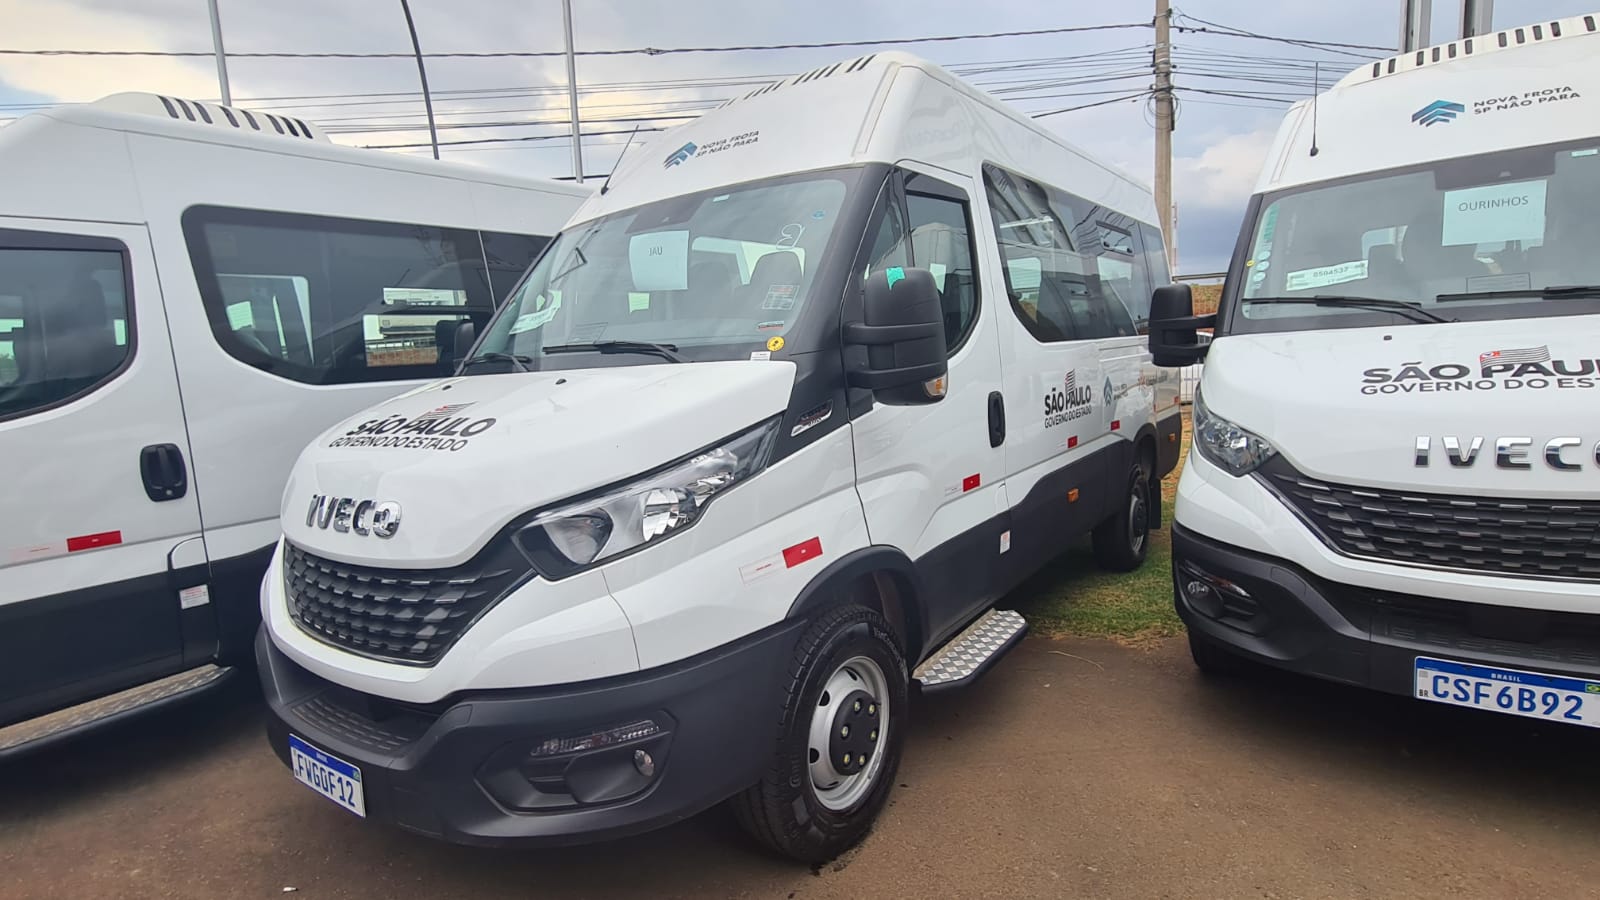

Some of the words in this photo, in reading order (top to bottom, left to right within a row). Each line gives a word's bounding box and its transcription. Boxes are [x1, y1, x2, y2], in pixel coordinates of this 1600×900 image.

[1474, 95, 1518, 107] NOVA
[1524, 86, 1572, 98] FROTA
[1474, 106, 1491, 115] SP
[1497, 99, 1532, 111] NÃO
[1538, 92, 1581, 104] PARA
[695, 150, 708, 158] SP
[708, 143, 731, 154] NÃO
[732, 136, 759, 148] PARA
[700, 139, 727, 151] NOVA
[729, 130, 760, 143] FROTA
[1458, 195, 1529, 212] OURINHOS
[1361, 361, 1471, 384] SÃO
[1481, 359, 1600, 379] PAU
[1360, 380, 1497, 395] GOVERNO
[1504, 378, 1550, 390] DO
[1557, 377, 1600, 389] ES
[1045, 387, 1064, 416] SÃO
[1066, 385, 1091, 410] PAULO
[346, 414, 407, 436] SÃO
[391, 417, 497, 438] PAULO
[329, 436, 388, 448] GOVERNO
[382, 436, 410, 448] DO
[404, 437, 469, 452] ESTADO
[1415, 436, 1600, 472] IVEC
[306, 494, 403, 541] IVECO
[1490, 672, 1522, 683] BRASIL
[1419, 688, 1429, 698] BR
[1432, 674, 1584, 721] CSF6B92
